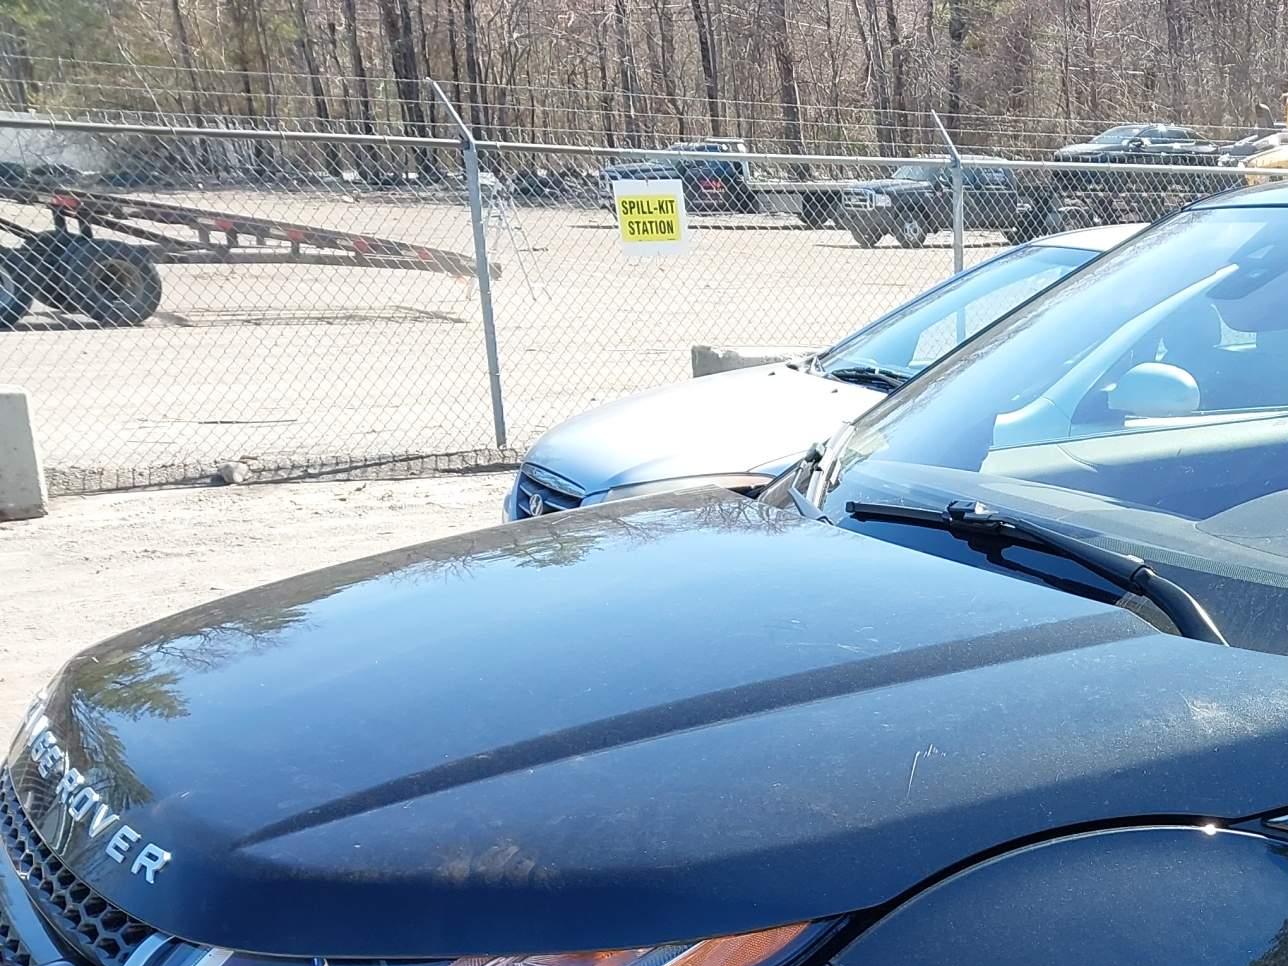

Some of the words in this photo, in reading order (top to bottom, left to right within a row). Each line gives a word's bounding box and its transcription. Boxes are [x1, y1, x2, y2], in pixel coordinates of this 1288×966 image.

[621, 199, 675, 215] SPILL-KIT
[628, 220, 674, 235] STATION
[56, 767, 172, 885] ROVER
